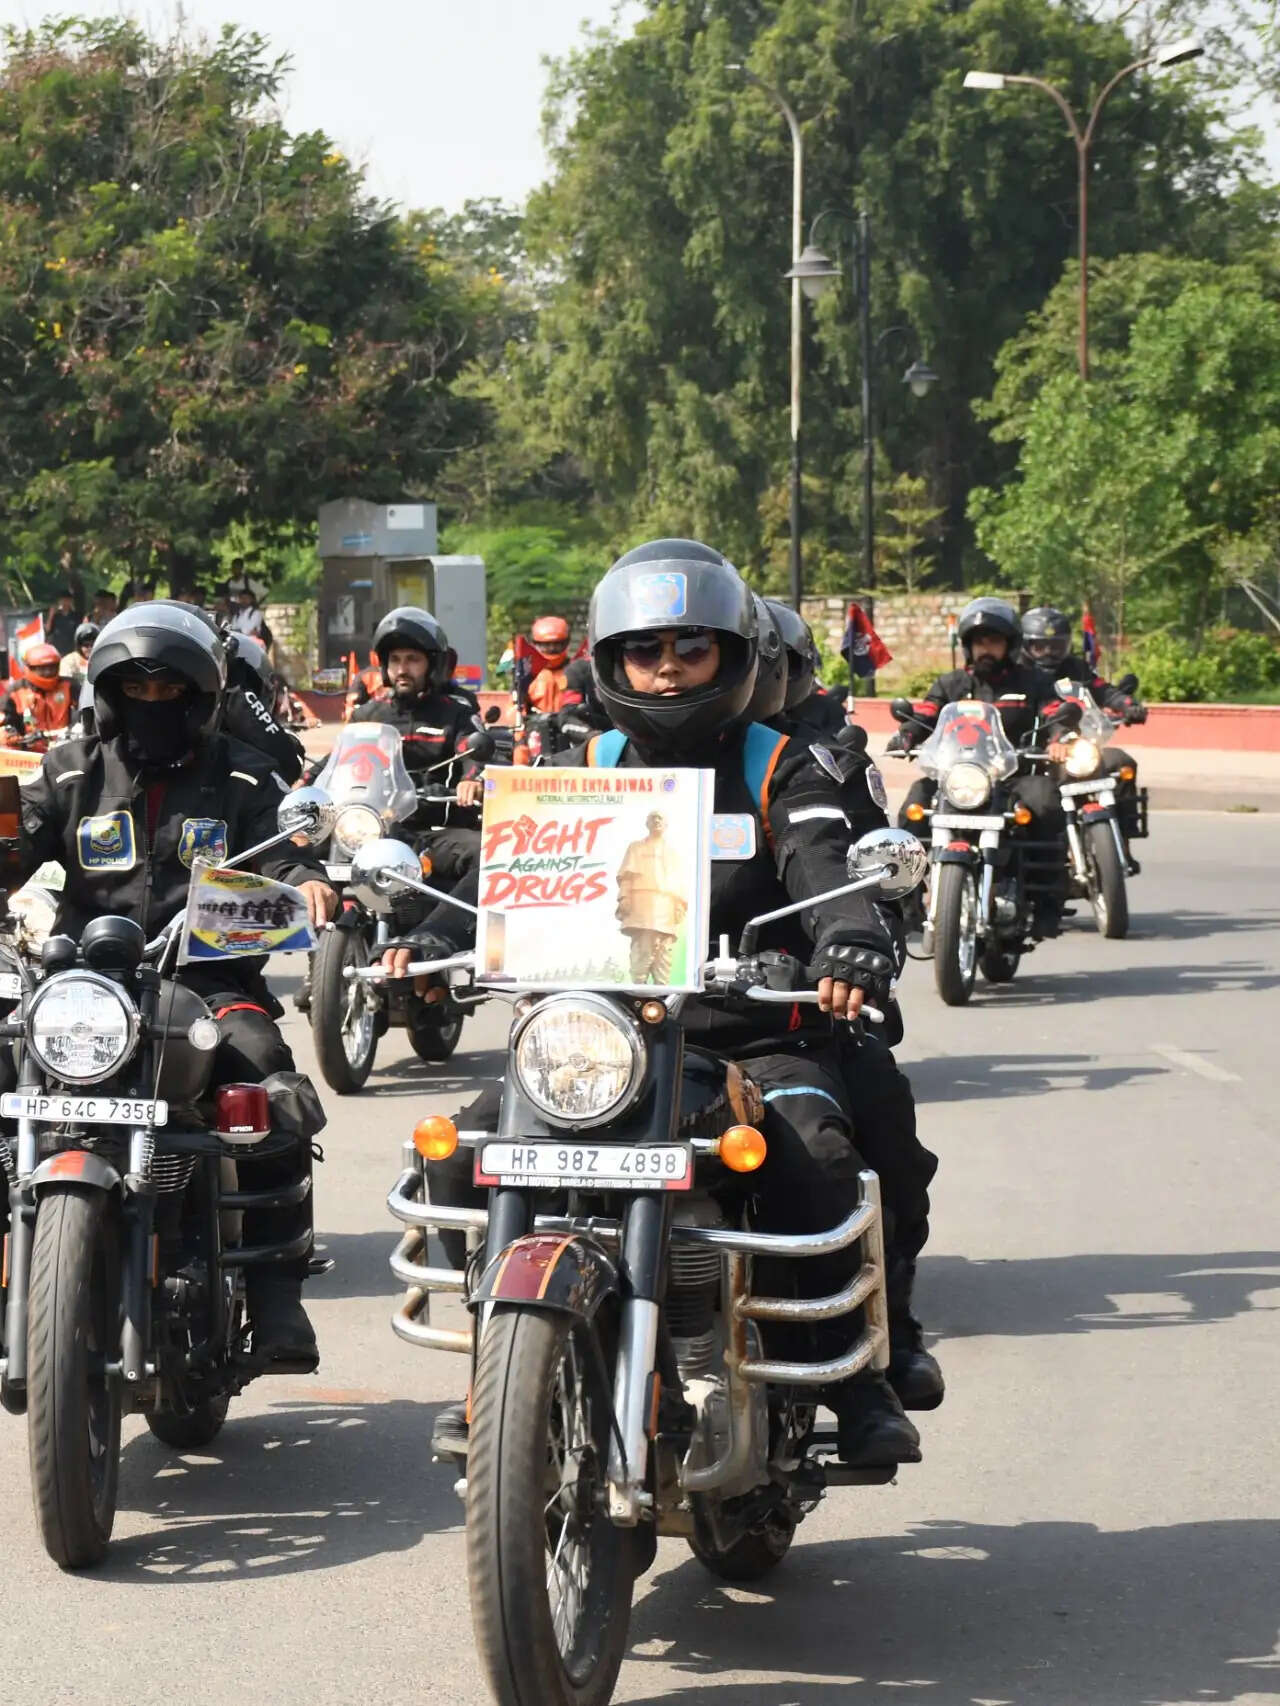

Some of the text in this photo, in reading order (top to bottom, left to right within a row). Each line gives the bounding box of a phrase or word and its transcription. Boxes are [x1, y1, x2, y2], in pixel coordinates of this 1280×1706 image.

[244, 690, 280, 735] CRPF
[511, 777, 654, 793] RASHTRIYA EKTA DIWAS
[481, 814, 616, 862] FIGHT
[101, 857, 128, 865] POLICE
[508, 856, 584, 872] AGAINST
[479, 871, 609, 908] DRUGS
[26, 1098, 156, 1121] HP 64C 7358
[511, 1149, 677, 1173] HR 98Z 4898
